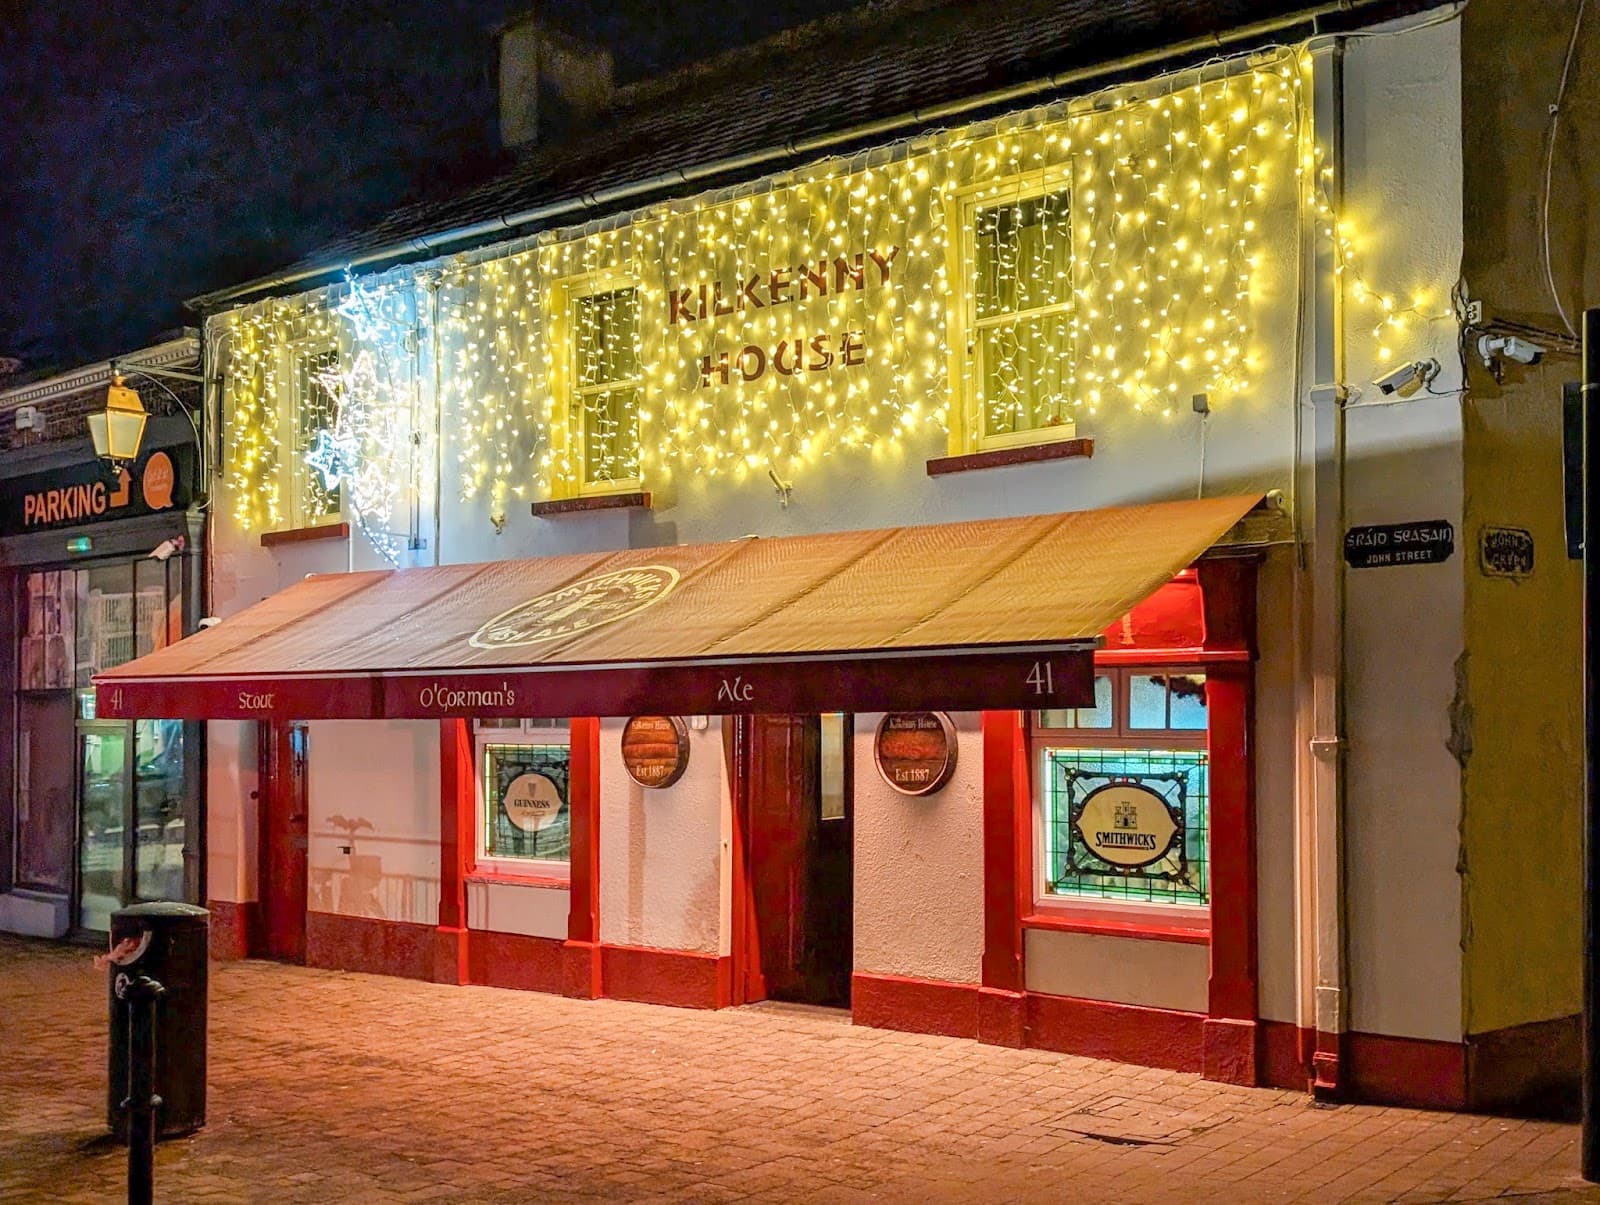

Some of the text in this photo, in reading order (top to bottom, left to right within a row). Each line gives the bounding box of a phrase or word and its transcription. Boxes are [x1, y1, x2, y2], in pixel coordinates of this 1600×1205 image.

[669, 245, 900, 325] KILKENNY
[701, 329, 866, 388] HOUSE
[24, 481, 107, 526] PARKING
[1366, 550, 1432, 565] JOHN STREET
[718, 676, 754, 701] Ale
[1025, 661, 1054, 695] 41
[110, 688, 123, 711] 41
[420, 682, 515, 712] O'Gorman's
[895, 768, 930, 782] Est 1887
[513, 799, 551, 809] GUINNESS
[1095, 831, 1157, 851] SMITHWICKS
